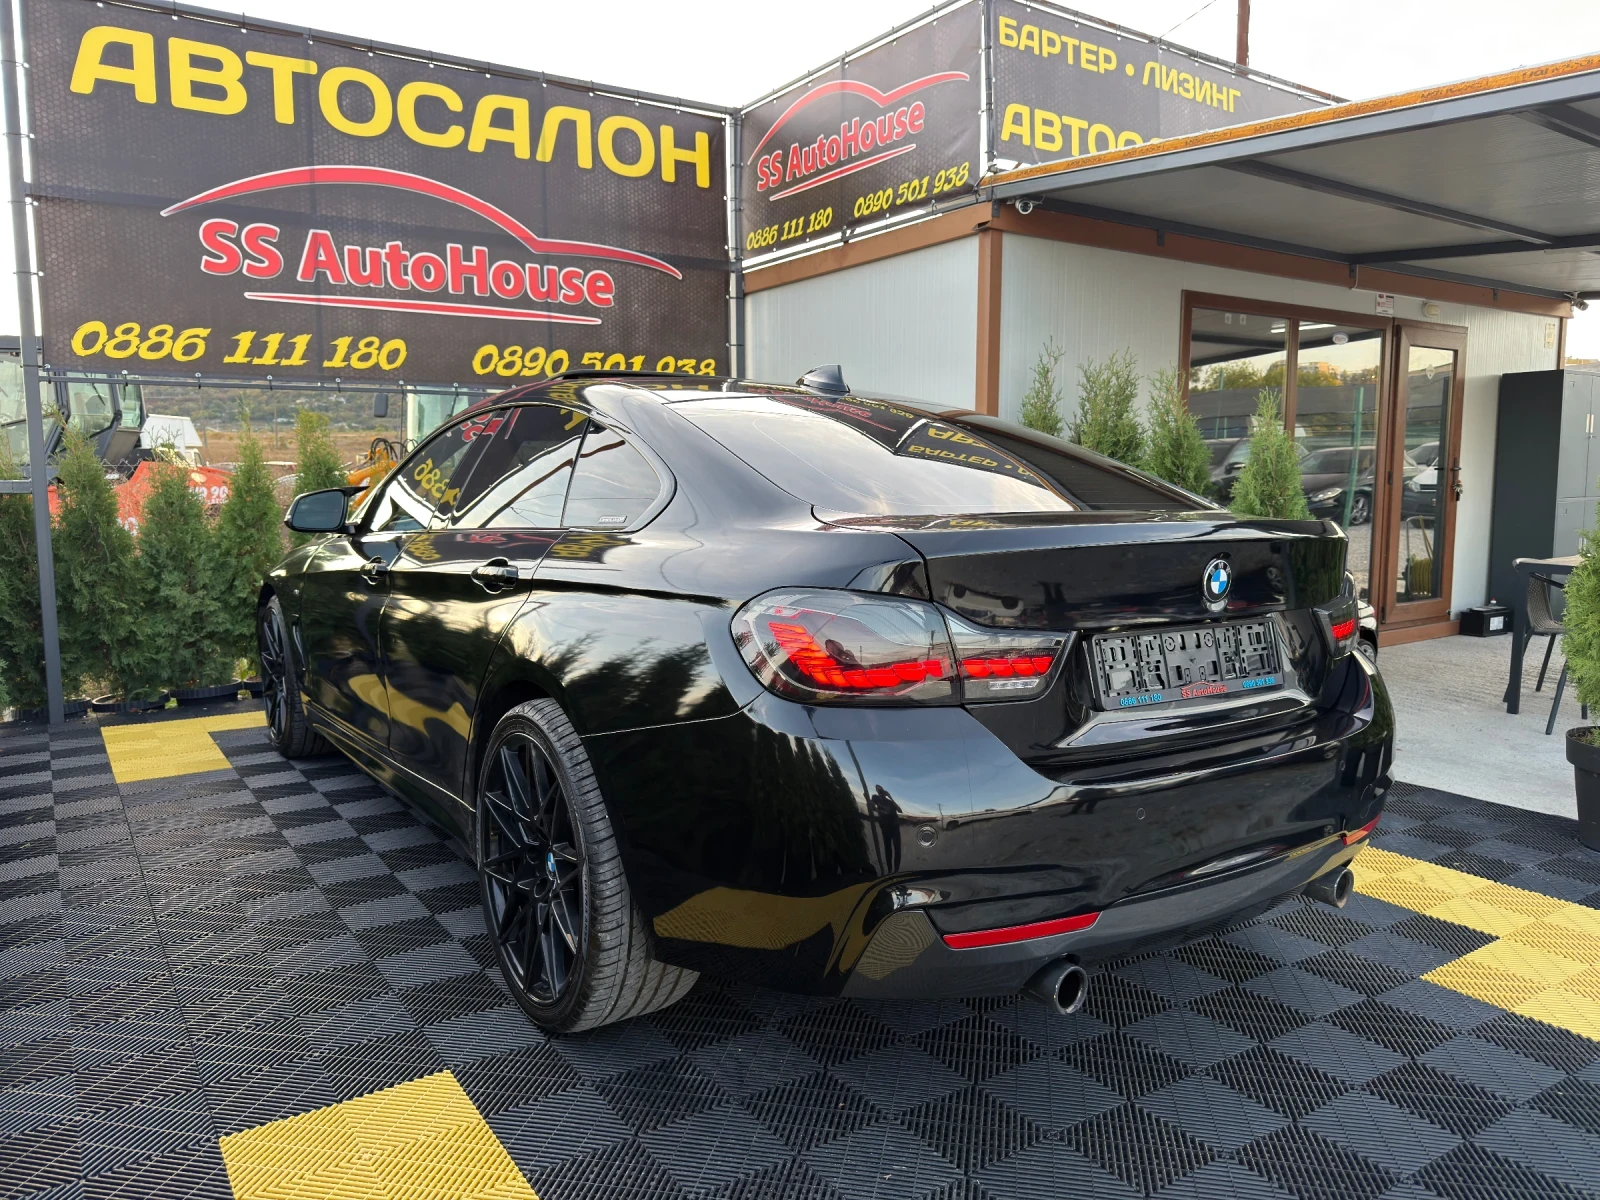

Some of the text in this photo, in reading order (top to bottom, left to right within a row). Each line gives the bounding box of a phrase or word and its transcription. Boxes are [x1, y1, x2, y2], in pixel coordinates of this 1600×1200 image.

[998, 15, 1242, 113] БАРТЕР ЛИЗИНГ
[70, 25, 711, 189] АВТОСАЛОН
[757, 101, 926, 191] SS AutoHouse
[853, 161, 969, 218] 0890 501 938
[746, 207, 833, 250] 0886 111 180
[199, 217, 615, 307] SS AutoHouse
[70, 320, 407, 371] 0886 111 180
[472, 344, 569, 378] 0890
[1209, 562, 1231, 575] BMW
[1192, 684, 1228, 697] AutoHouse
